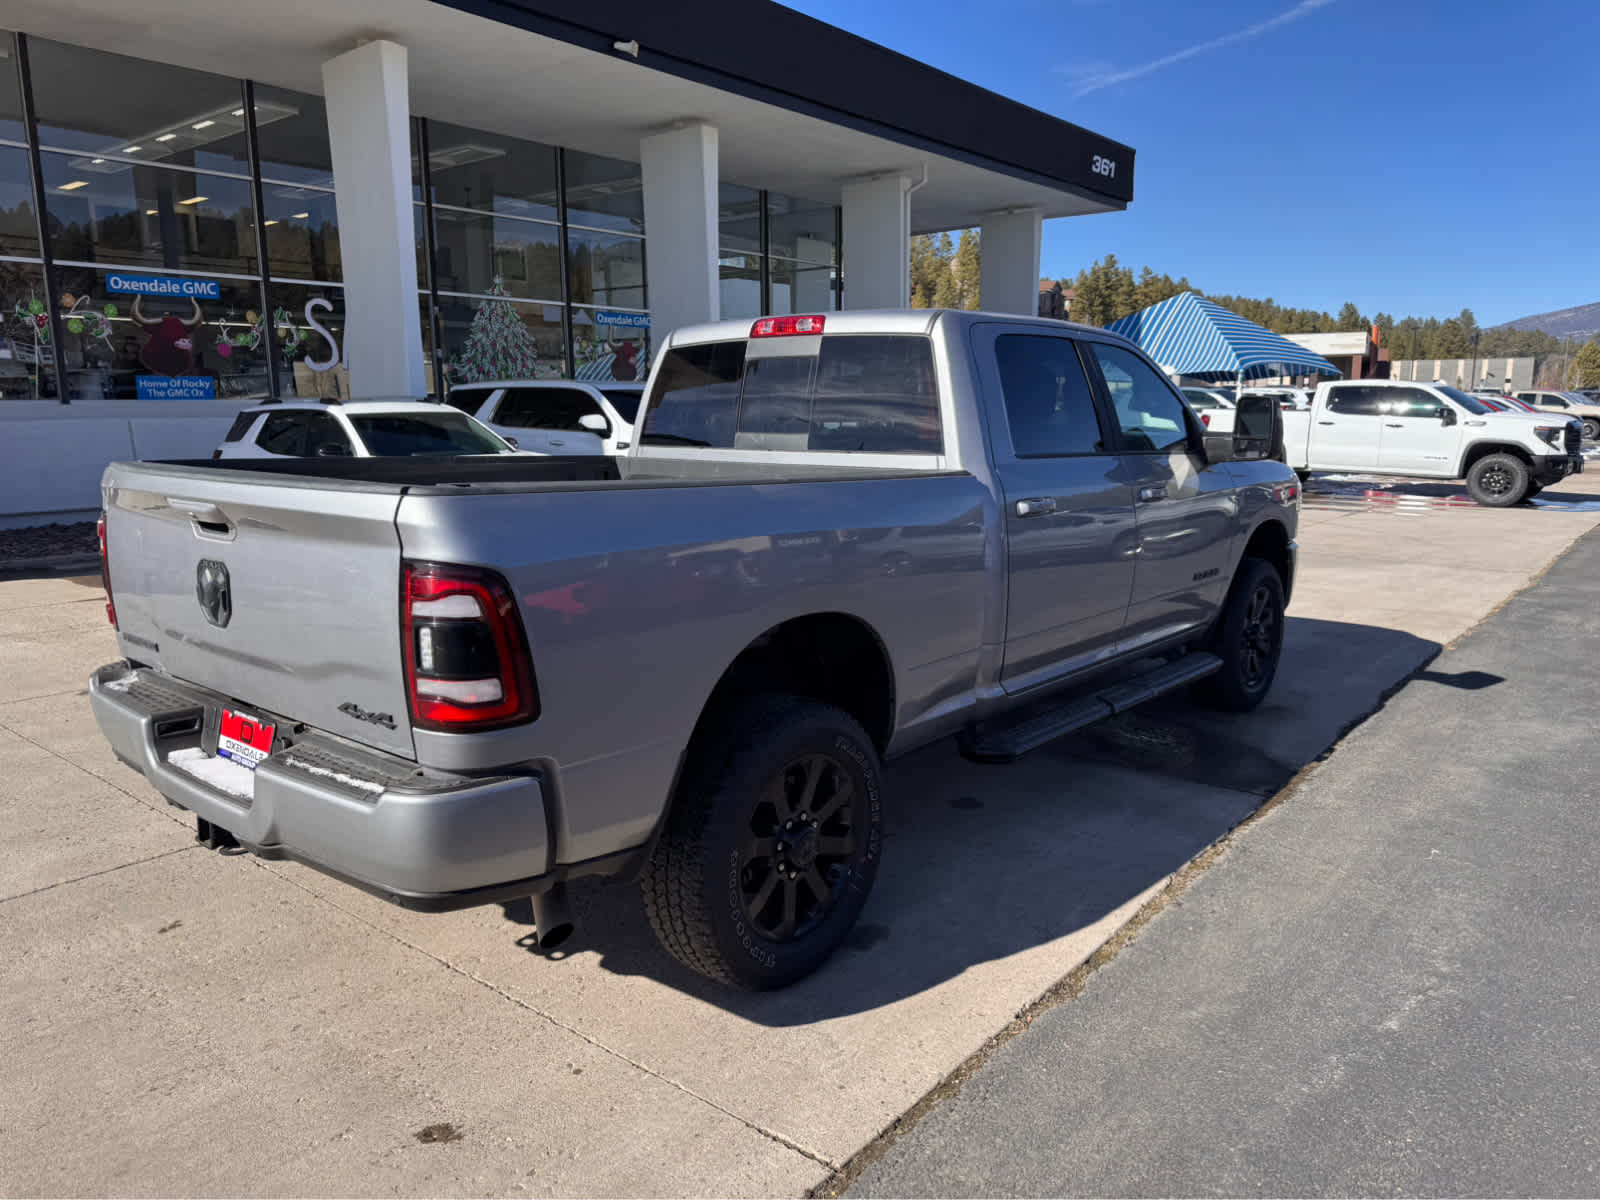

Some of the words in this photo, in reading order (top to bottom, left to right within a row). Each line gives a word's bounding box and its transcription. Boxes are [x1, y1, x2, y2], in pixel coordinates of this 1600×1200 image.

[1091, 154, 1116, 179] 361
[110, 276, 180, 293] Oxendale
[182, 281, 217, 295] GMC
